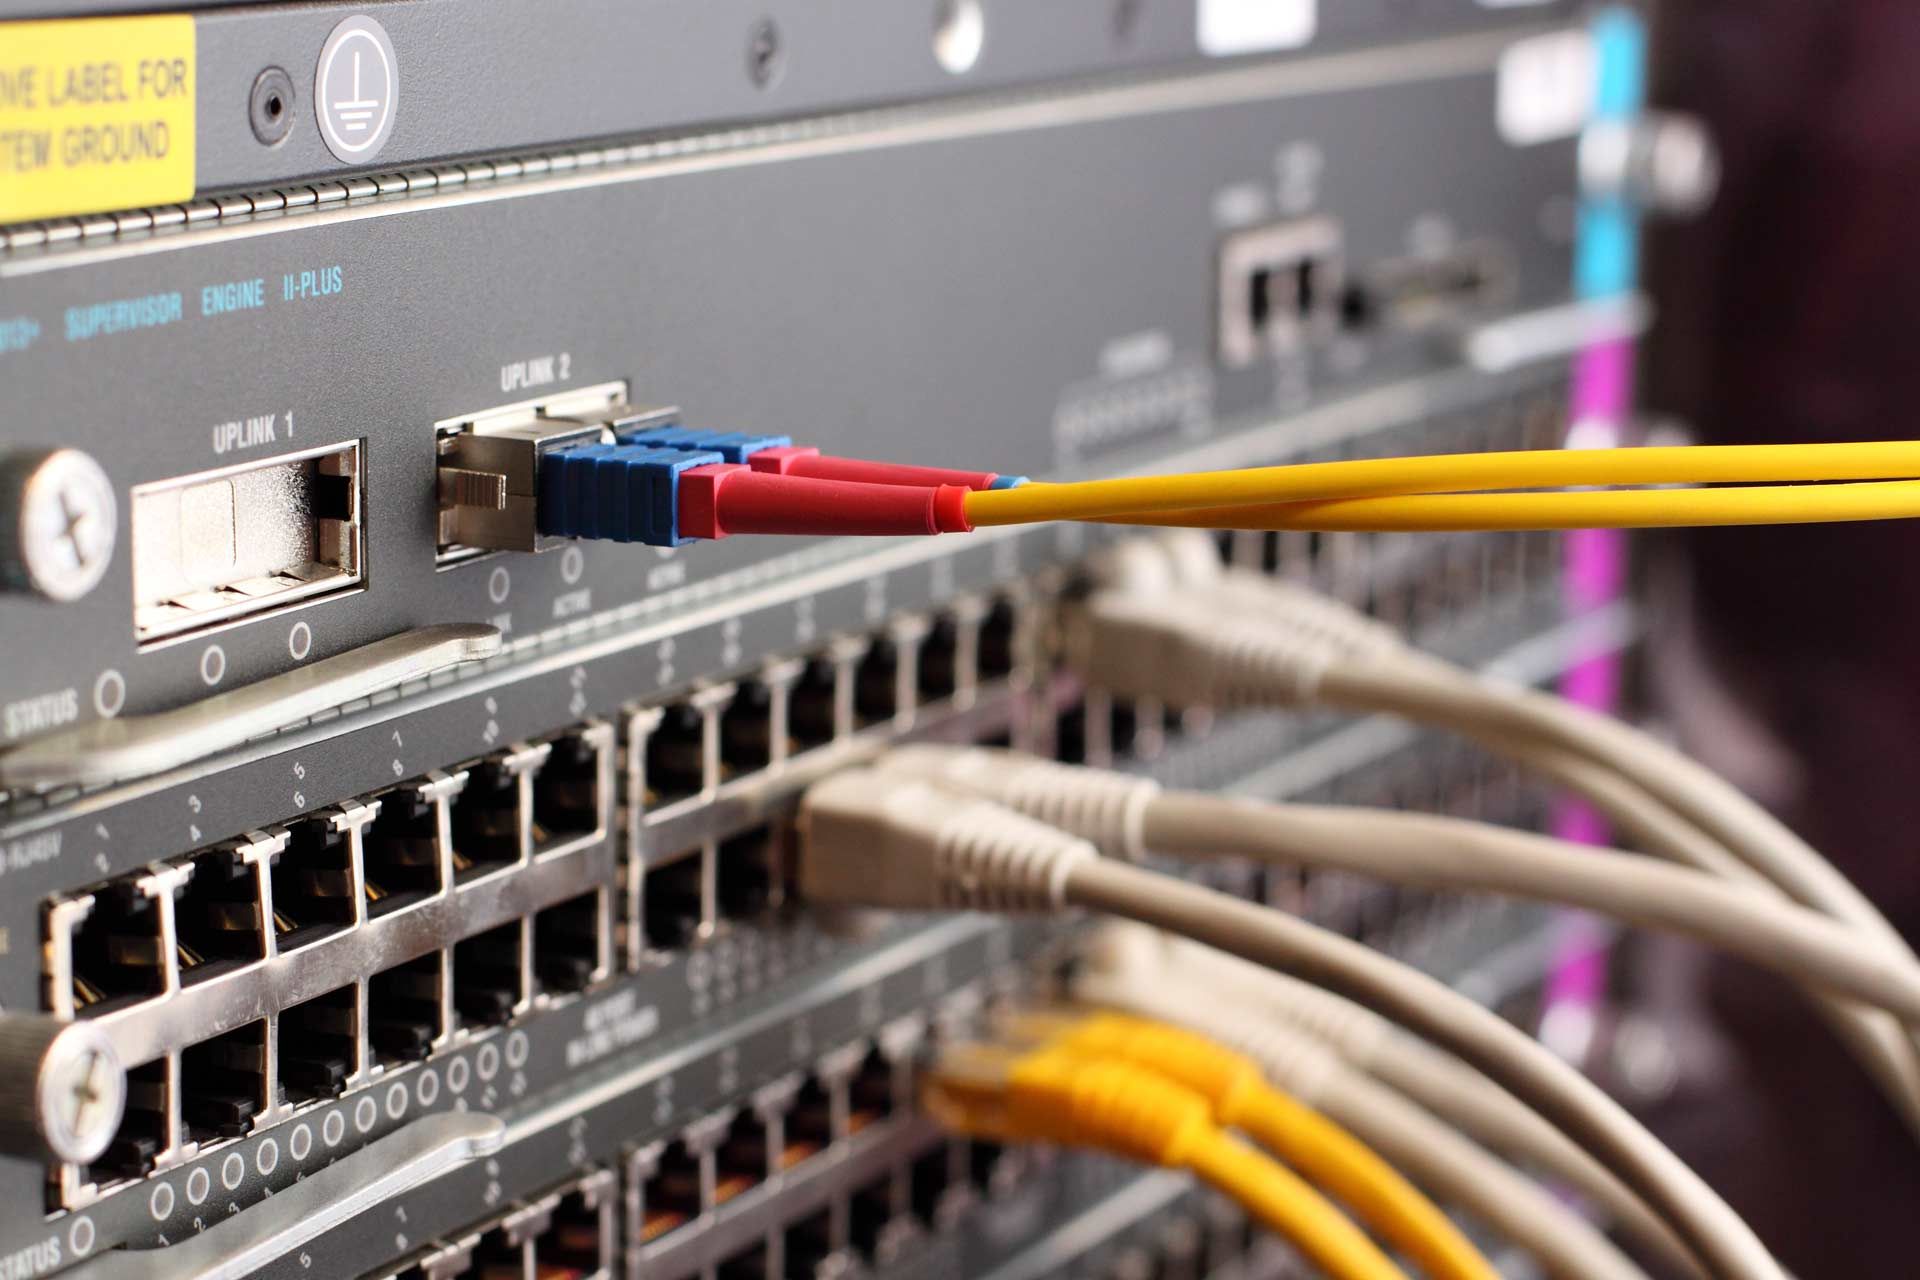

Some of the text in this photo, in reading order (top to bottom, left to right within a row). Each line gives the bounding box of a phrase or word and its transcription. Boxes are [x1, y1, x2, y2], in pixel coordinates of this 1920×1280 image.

[0, 58, 187, 109] VE LABEL FOR
[61, 121, 169, 168] GROUND
[64, 291, 183, 342] SUPERVISOR
[202, 278, 265, 317] ENGINE
[283, 265, 343, 301] II-PLUS
[501, 352, 571, 392] UPLINK 2
[213, 410, 293, 454] UPLINK 1
[4, 687, 78, 738] STATUS
[294, 761, 306, 779] 5
[392, 760, 404, 776] 8
[294, 791, 306, 809] 6
[229, 1201, 241, 1214] 3
[194, 1217, 206, 1232] 2
[300, 1252, 311, 1269] 5
